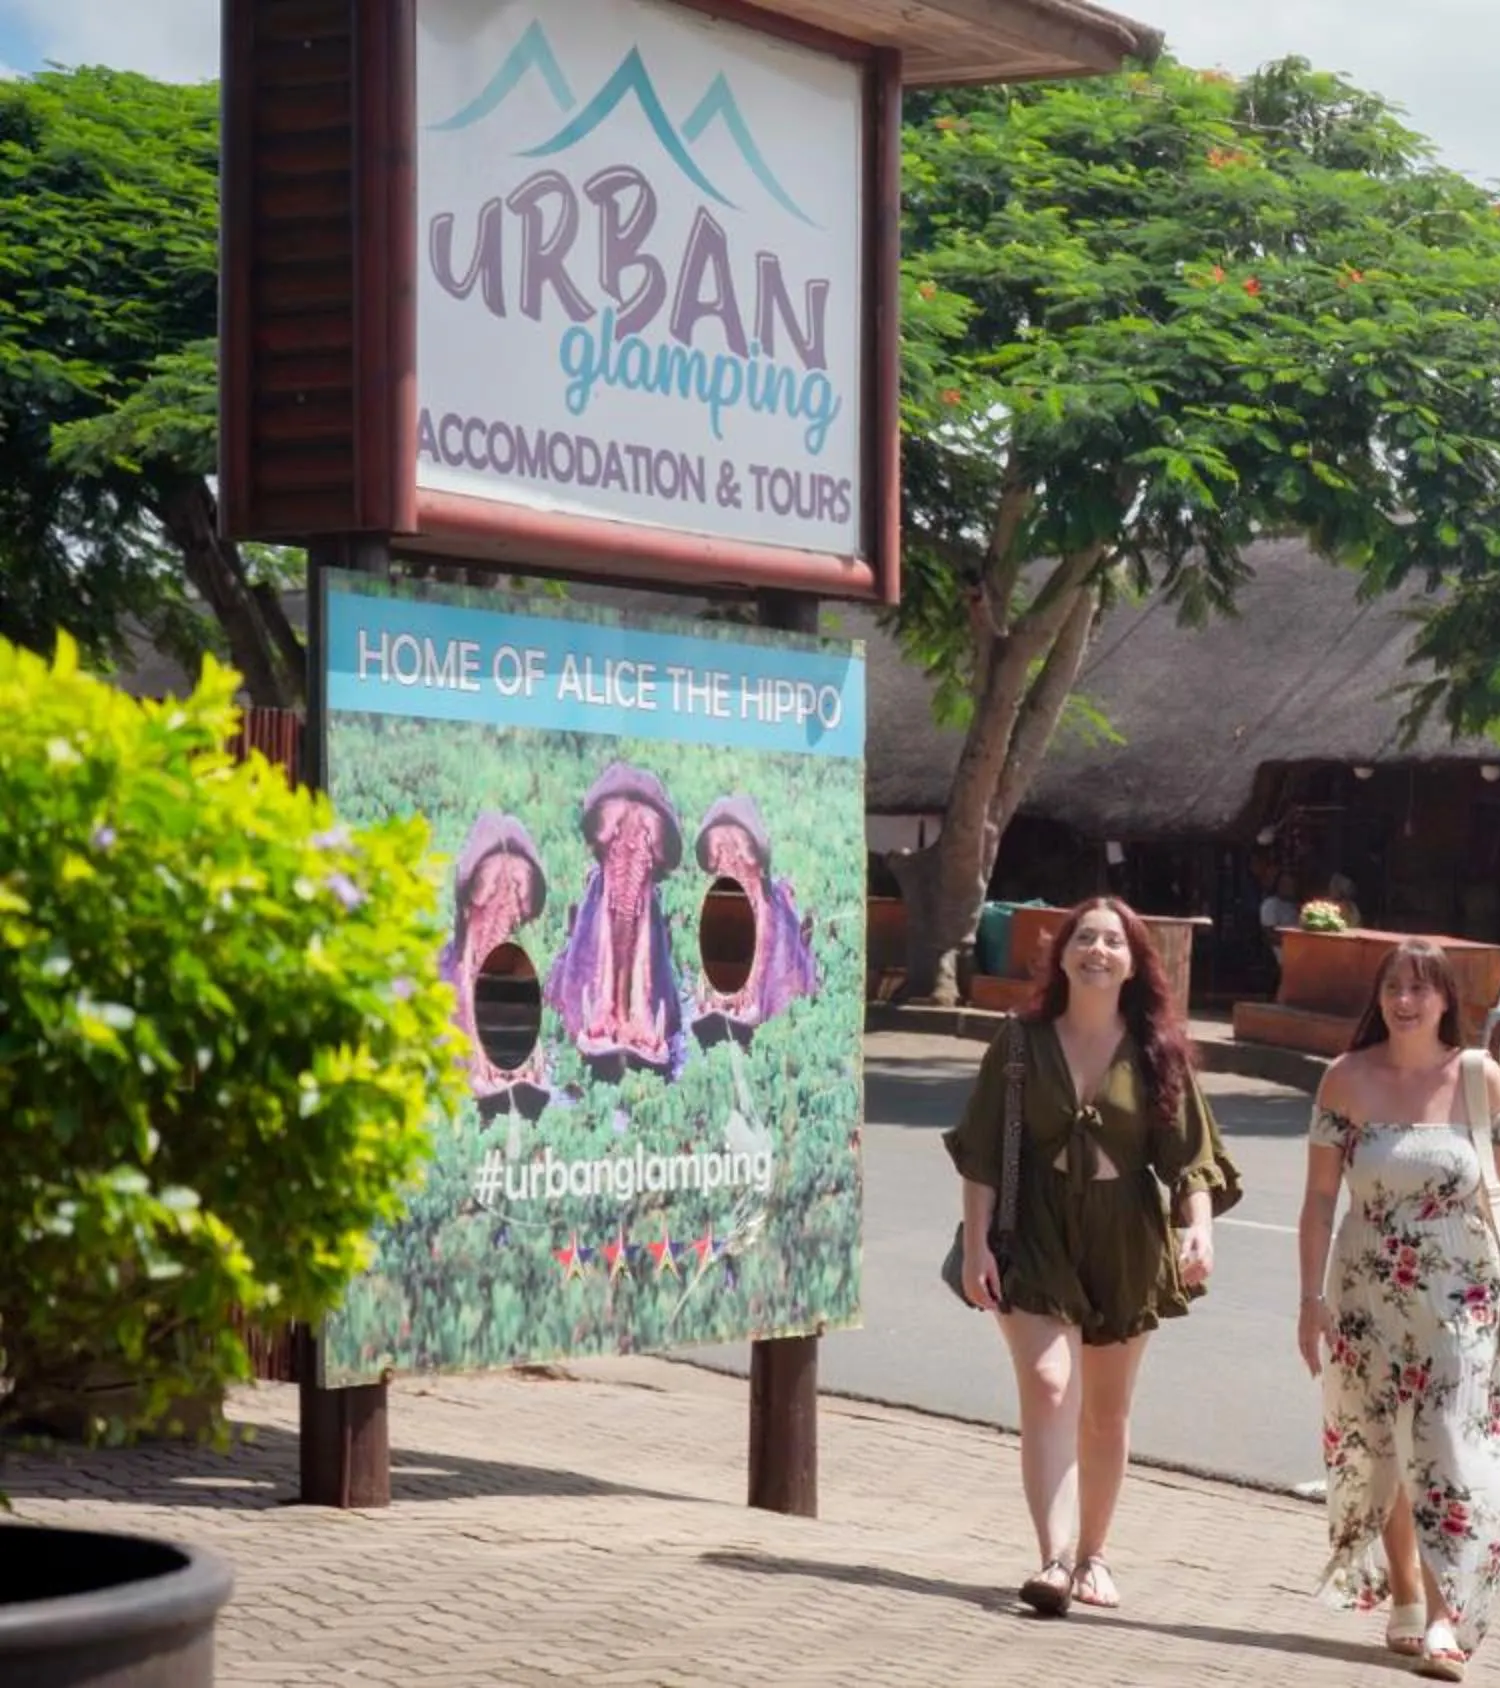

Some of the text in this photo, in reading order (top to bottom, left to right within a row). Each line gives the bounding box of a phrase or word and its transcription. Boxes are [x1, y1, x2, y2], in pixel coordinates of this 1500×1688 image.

[430, 165, 829, 369] URBAN
[560, 306, 841, 456] glamping
[416, 408, 851, 525] ACCOMODATION & TOURS
[358, 630, 843, 729] HOME OF ALICE THE HIPPO
[474, 1143, 772, 1205] #urbanglamping
